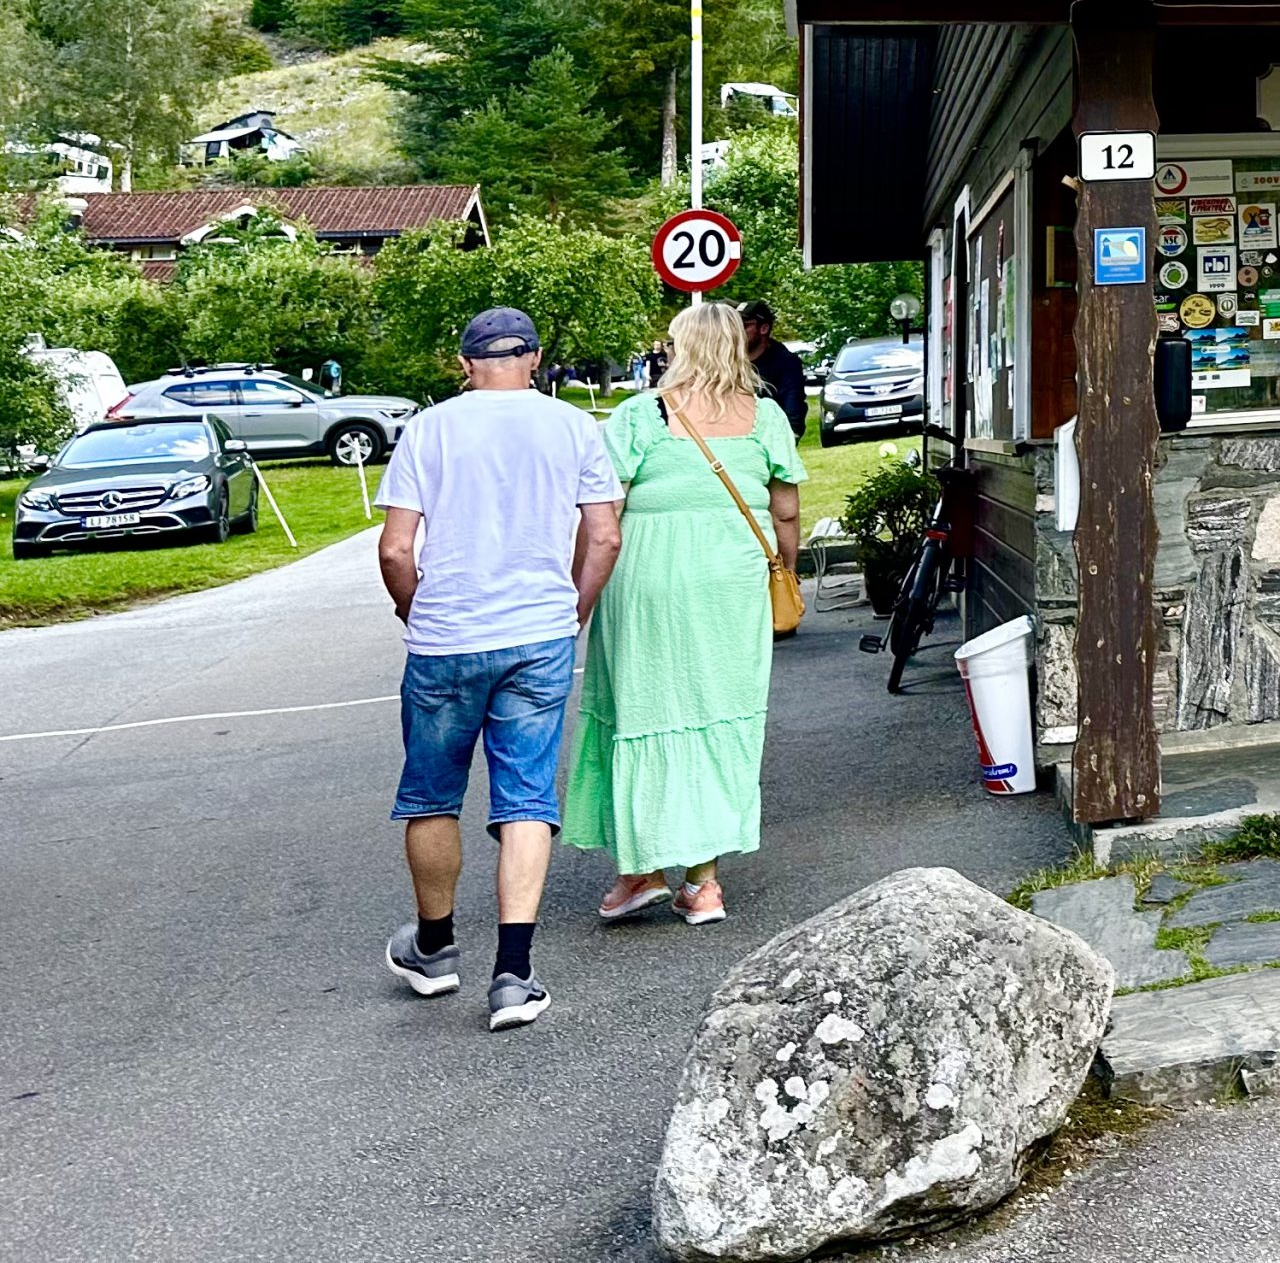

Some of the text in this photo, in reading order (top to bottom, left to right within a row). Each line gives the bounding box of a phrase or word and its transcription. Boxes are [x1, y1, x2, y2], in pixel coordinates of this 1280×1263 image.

[1101, 144, 1134, 169] 12
[672, 229, 726, 269] 20
[1204, 257, 1229, 273] rbl
[106, 514, 135, 524] 78158
